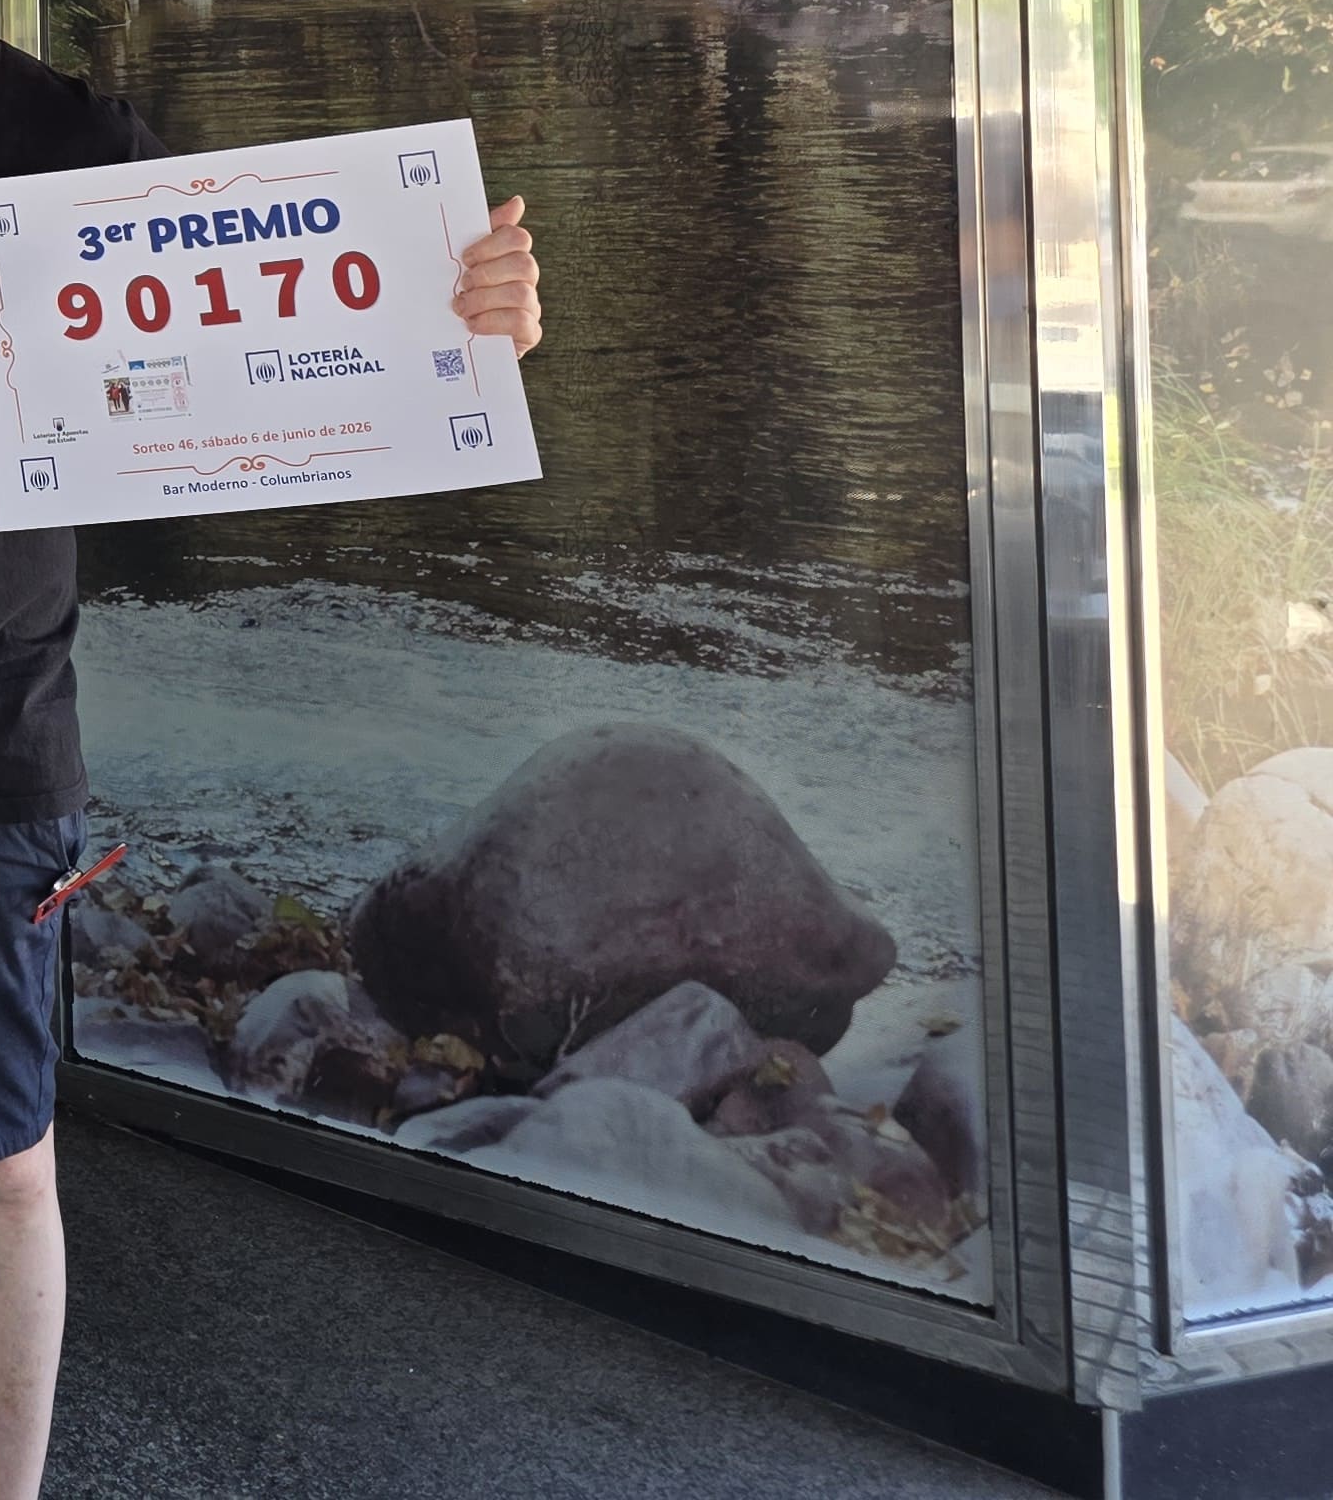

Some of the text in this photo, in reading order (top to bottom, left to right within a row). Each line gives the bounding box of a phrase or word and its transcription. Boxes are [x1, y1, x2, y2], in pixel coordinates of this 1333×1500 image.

[77, 197, 341, 262] 3er PREMIO
[287, 345, 364, 366] LOTERÍA
[290, 360, 386, 381] NACIONAL
[132, 421, 372, 456] Sorteo 46, sábado 6 de junio de 2026
[162, 467, 352, 496] Bar Moderno Columbrianos
